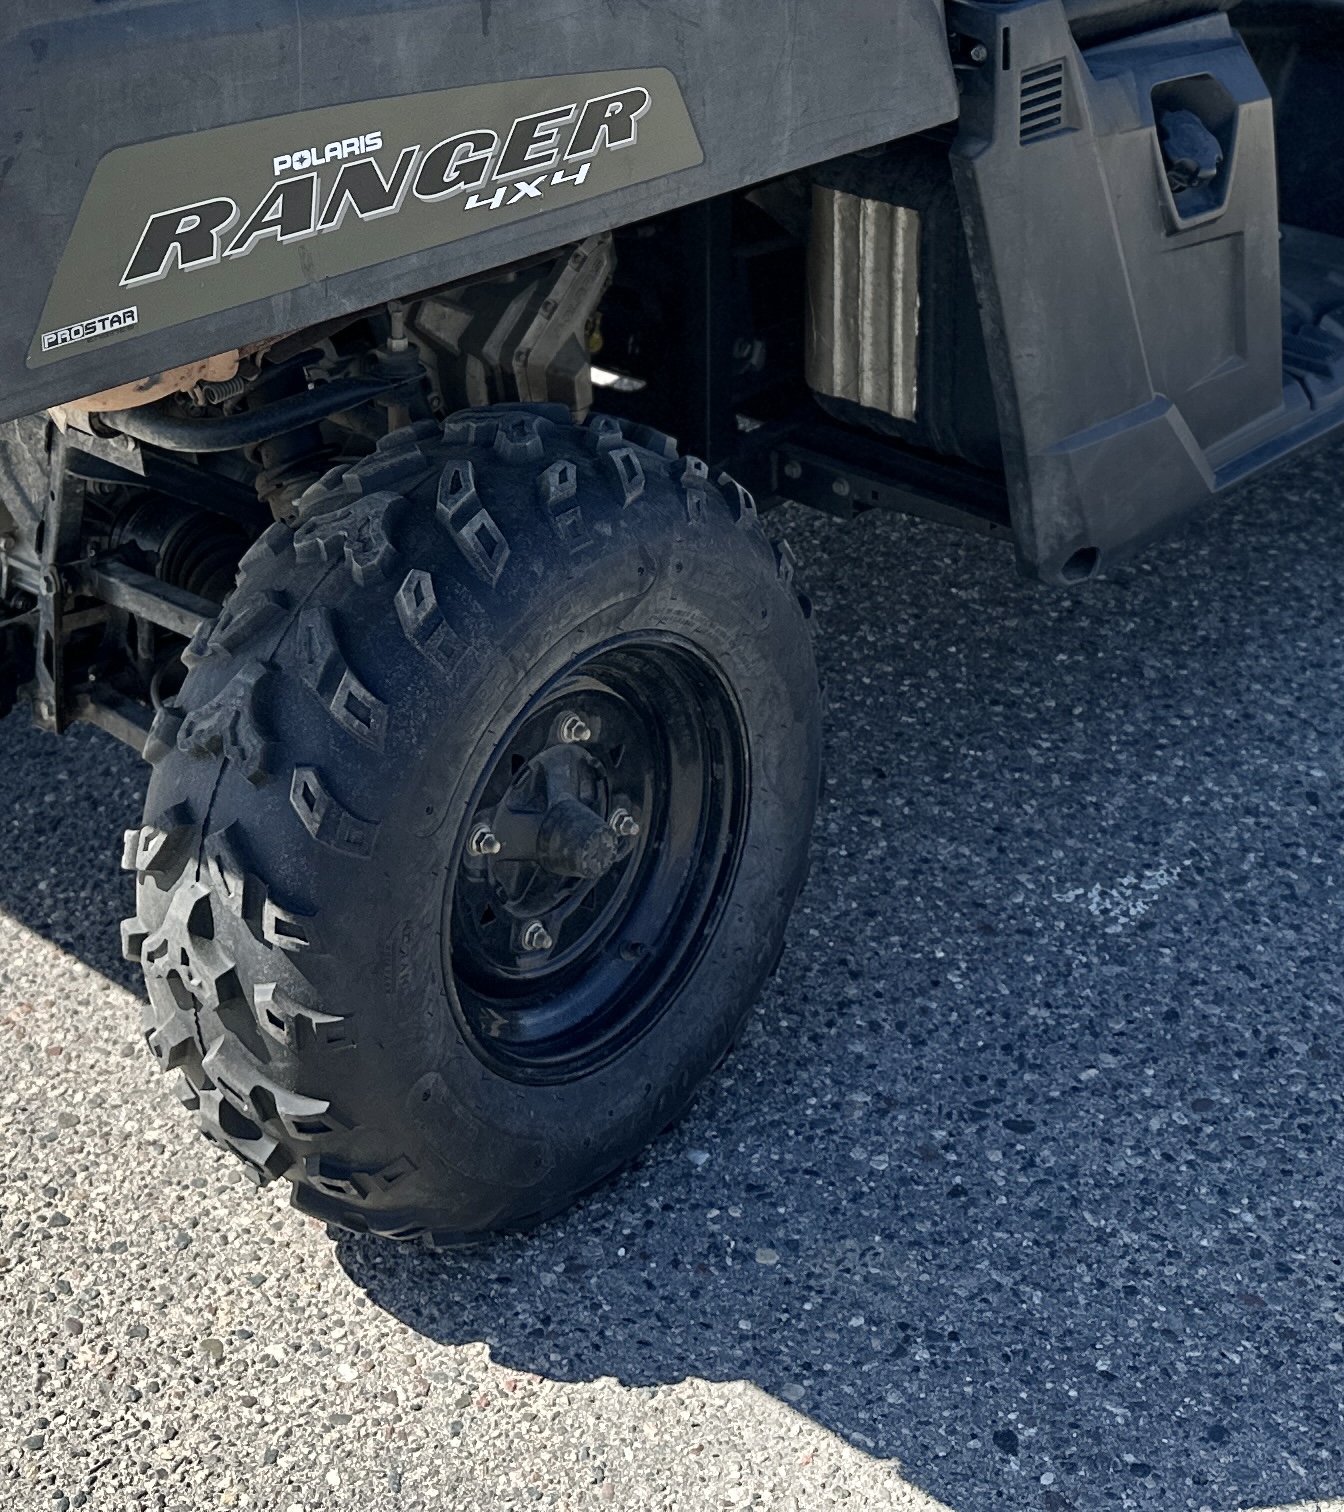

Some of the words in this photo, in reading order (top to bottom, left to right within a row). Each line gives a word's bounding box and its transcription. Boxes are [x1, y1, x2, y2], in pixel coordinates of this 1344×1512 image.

[272, 131, 383, 176] POLARIS
[118, 86, 654, 289] RANGER
[42, 307, 136, 350] PROSTAR
